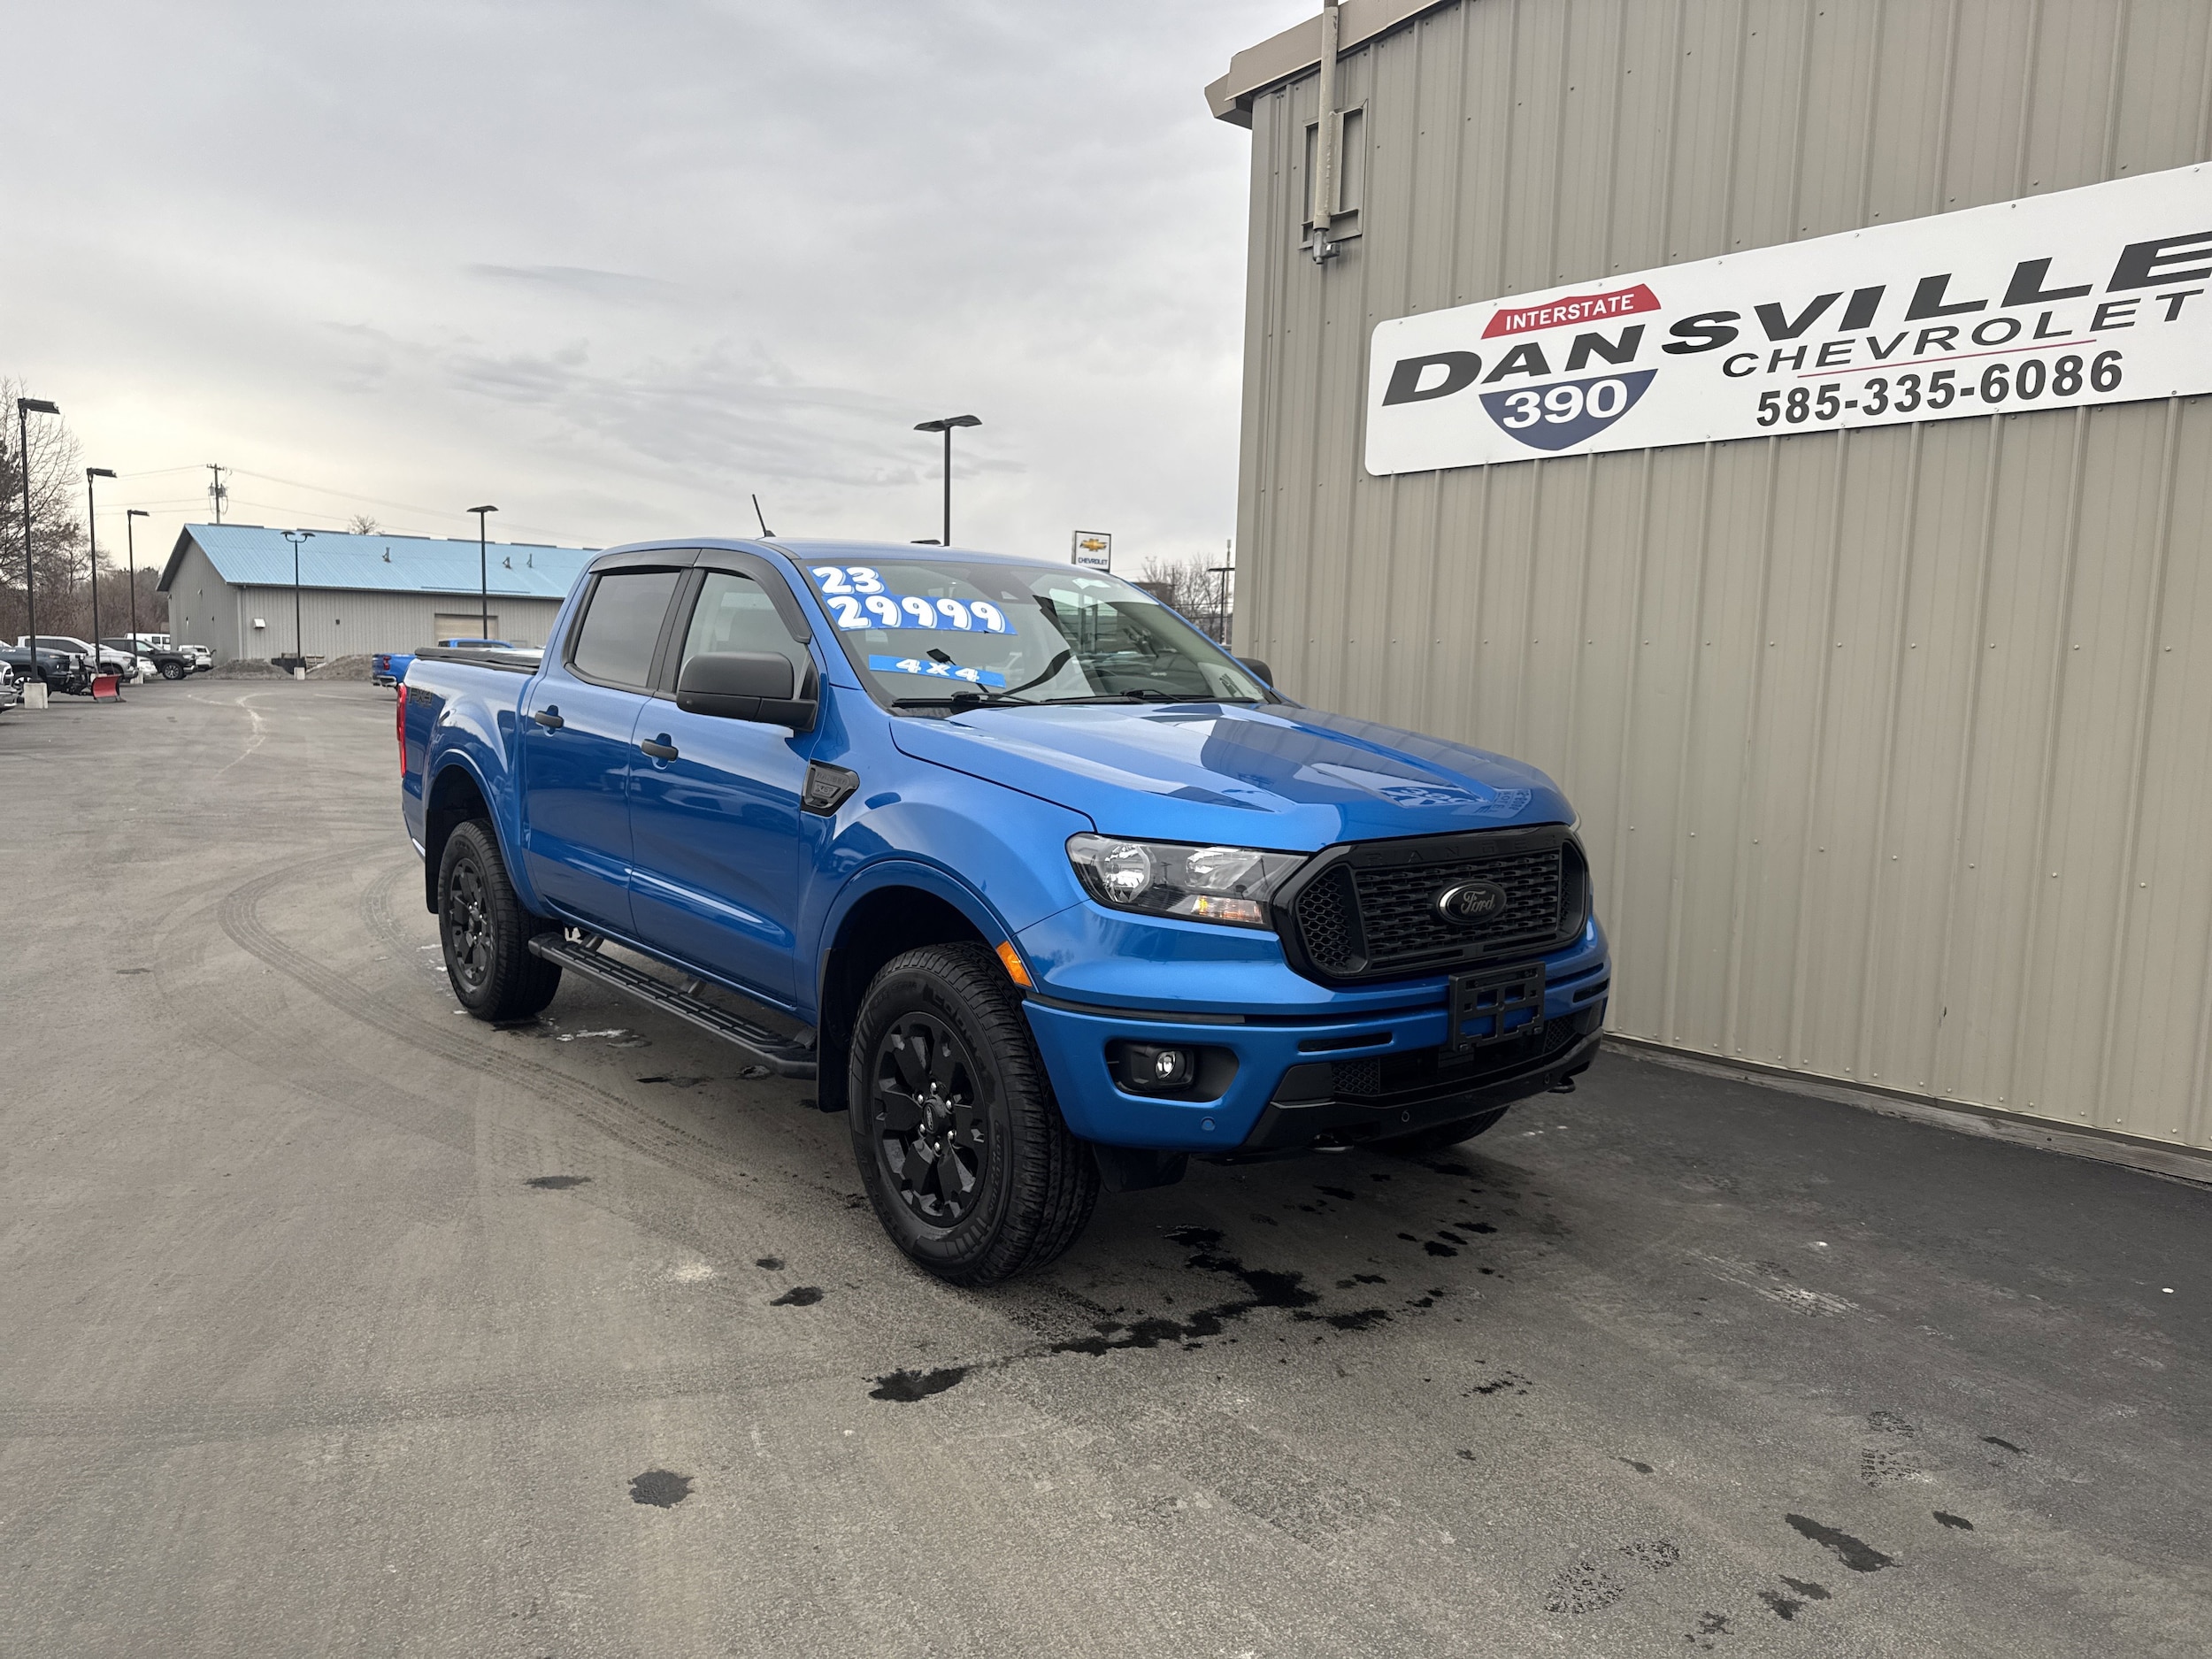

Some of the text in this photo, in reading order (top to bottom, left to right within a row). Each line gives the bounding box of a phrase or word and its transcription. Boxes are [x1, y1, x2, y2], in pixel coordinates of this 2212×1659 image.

[1381, 230, 2212, 407] DANSVILLE
[1505, 293, 1635, 331] INTERSTATE
[1722, 288, 2205, 378] CHEVROLET
[1502, 379, 1628, 429] 390
[1756, 350, 2124, 426] 585-335-6086
[812, 566, 885, 595] 23
[1078, 557, 1108, 565] CHEVROLET
[826, 595, 1007, 634] 29999
[1460, 890, 1495, 914] Ford
